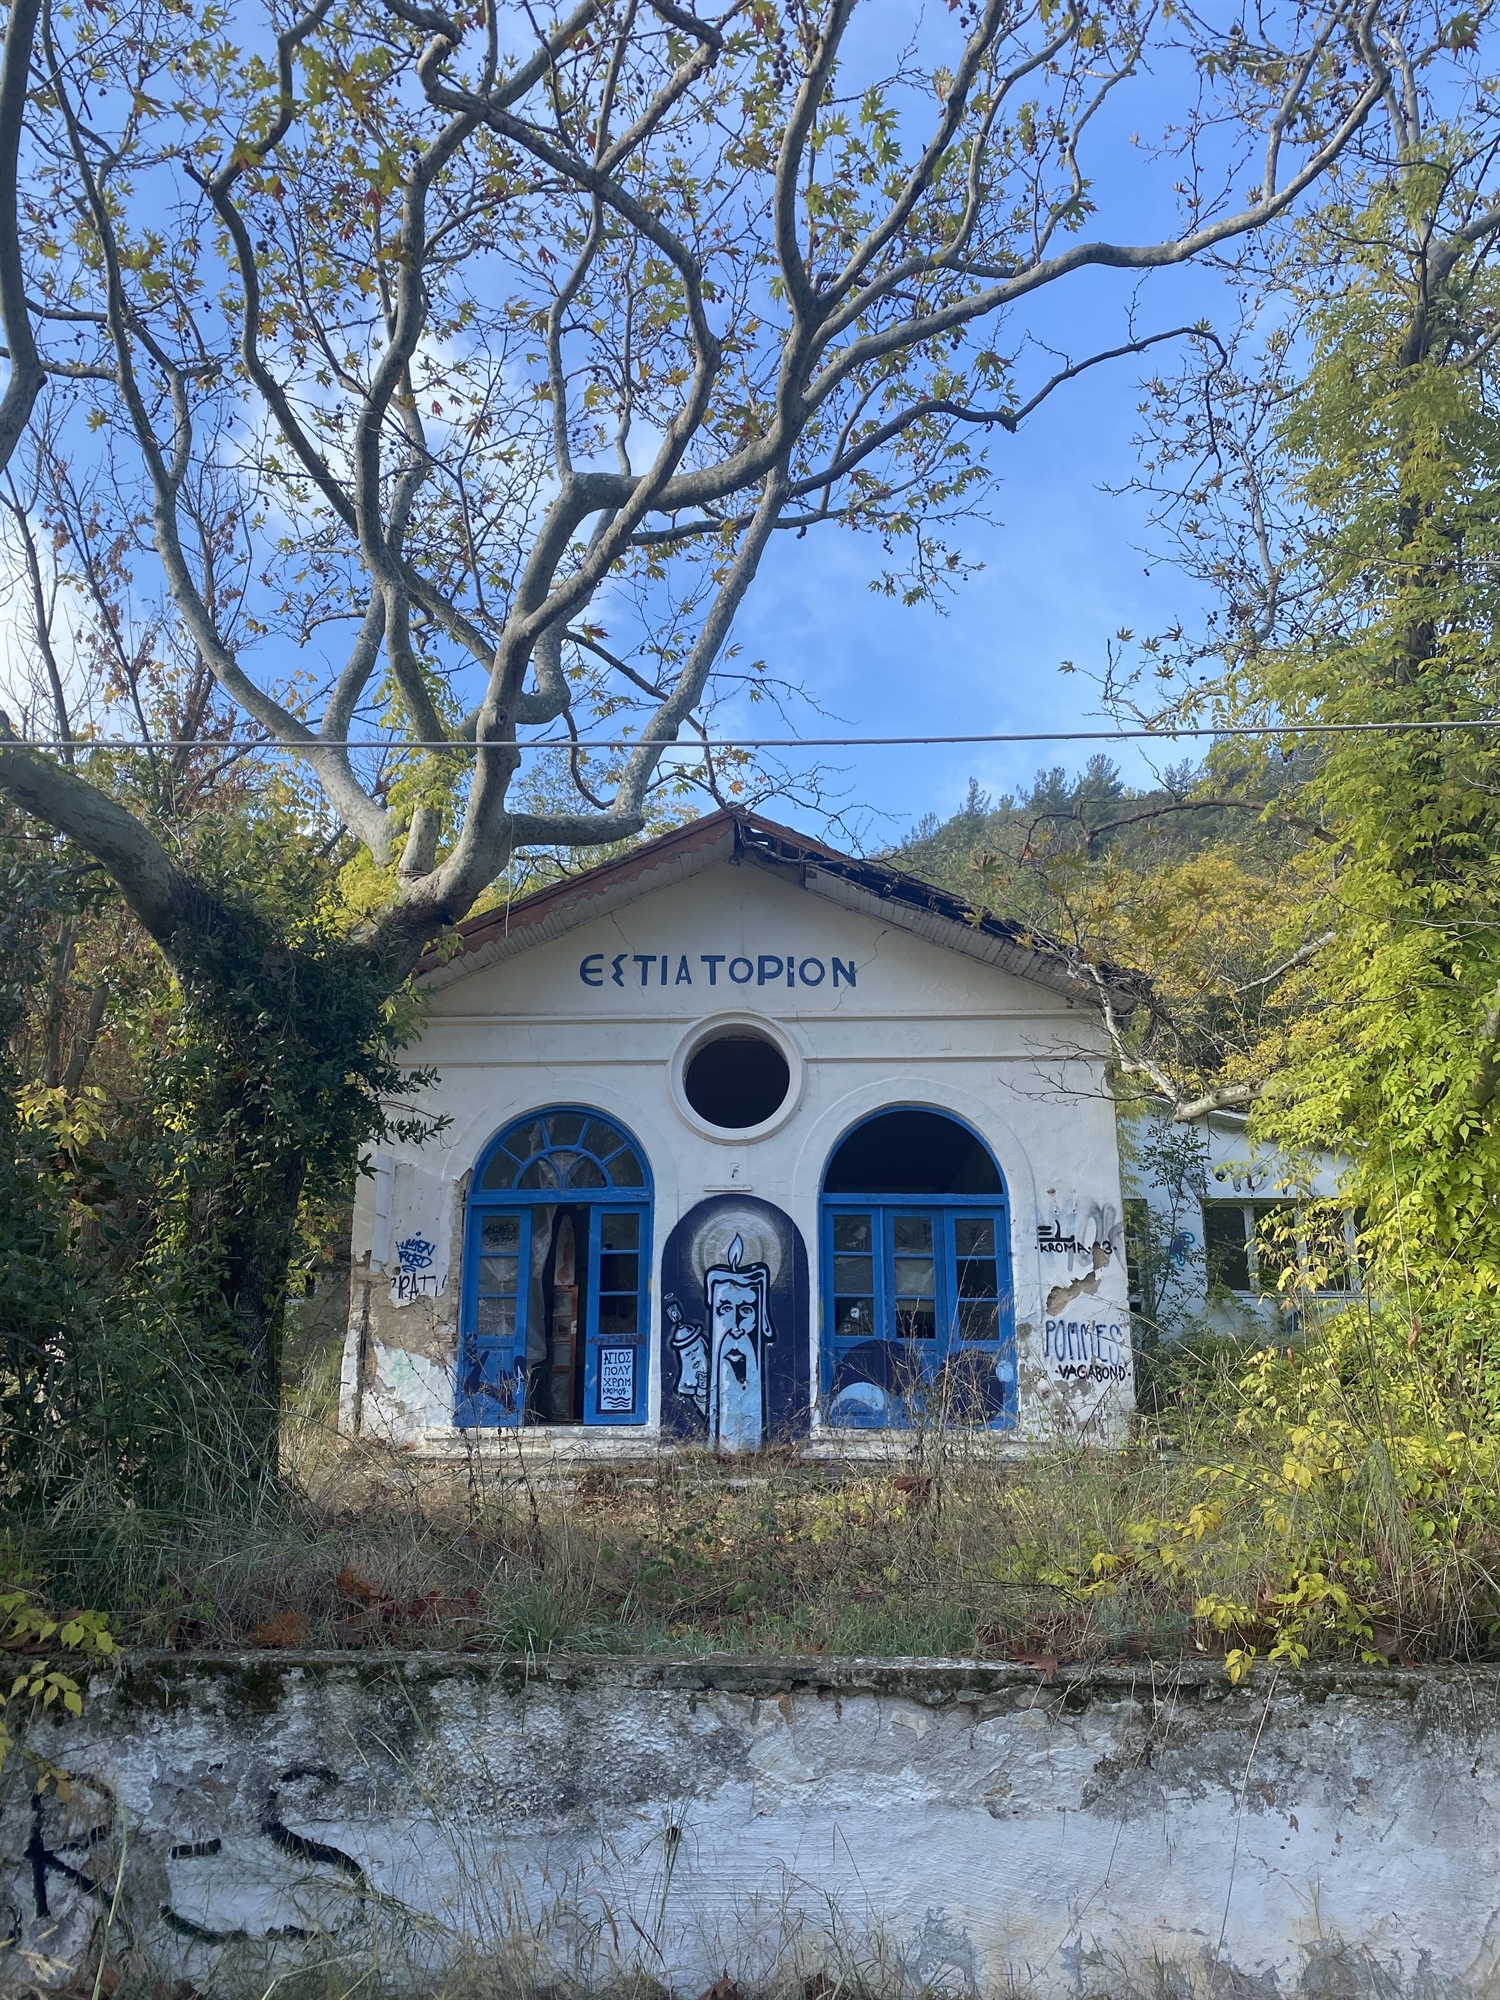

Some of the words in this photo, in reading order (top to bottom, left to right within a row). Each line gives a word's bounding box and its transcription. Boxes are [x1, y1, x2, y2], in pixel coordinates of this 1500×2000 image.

[579, 953, 857, 988] ΕΣΤΙΑΤΟΡΙΟΝ
[603, 1351, 632, 1365] ΑΓΙΟΣ
[604, 1365, 632, 1376] ΠΟΛΥ
[603, 1377, 632, 1388] ΧΡΩΜ
